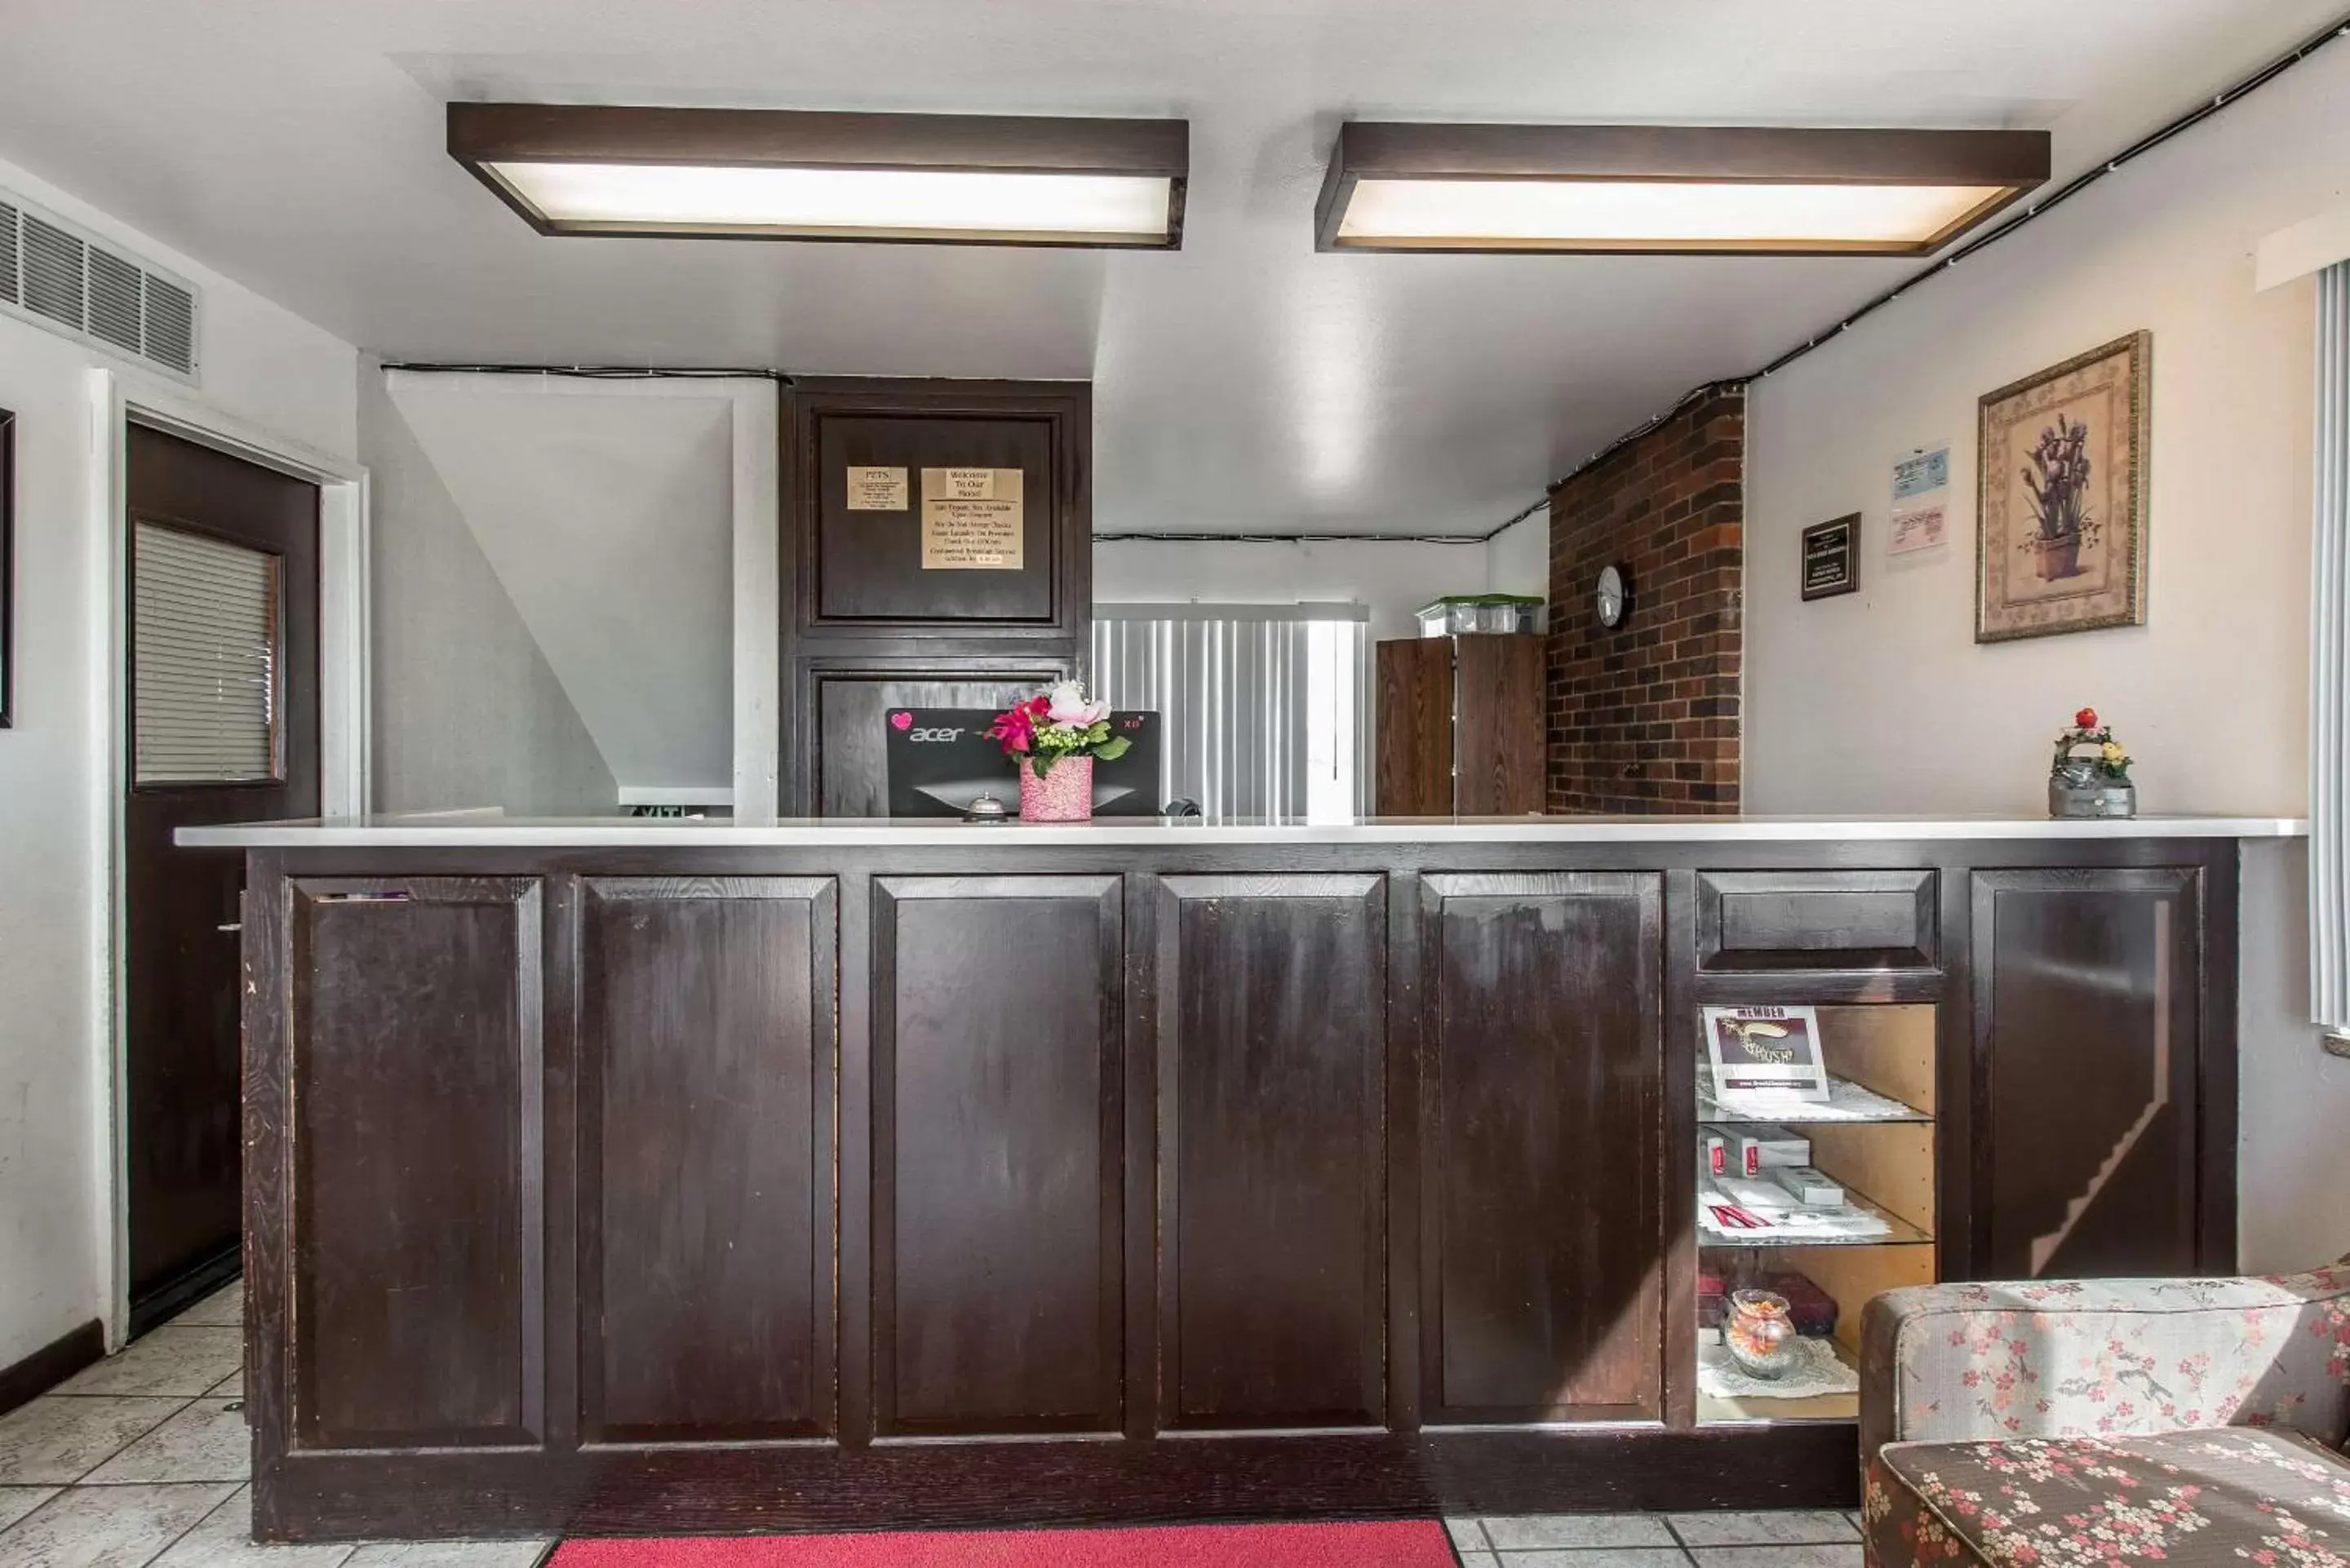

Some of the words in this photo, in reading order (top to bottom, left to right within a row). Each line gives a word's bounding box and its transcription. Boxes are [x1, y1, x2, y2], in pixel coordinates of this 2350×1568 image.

[867, 471, 889, 479] PETS
[950, 470, 987, 479] Welcome
[955, 480, 966, 488] To
[967, 480, 984, 488] Our
[910, 728, 965, 742] acer
[1737, 1006, 1785, 1018] MEMBER
